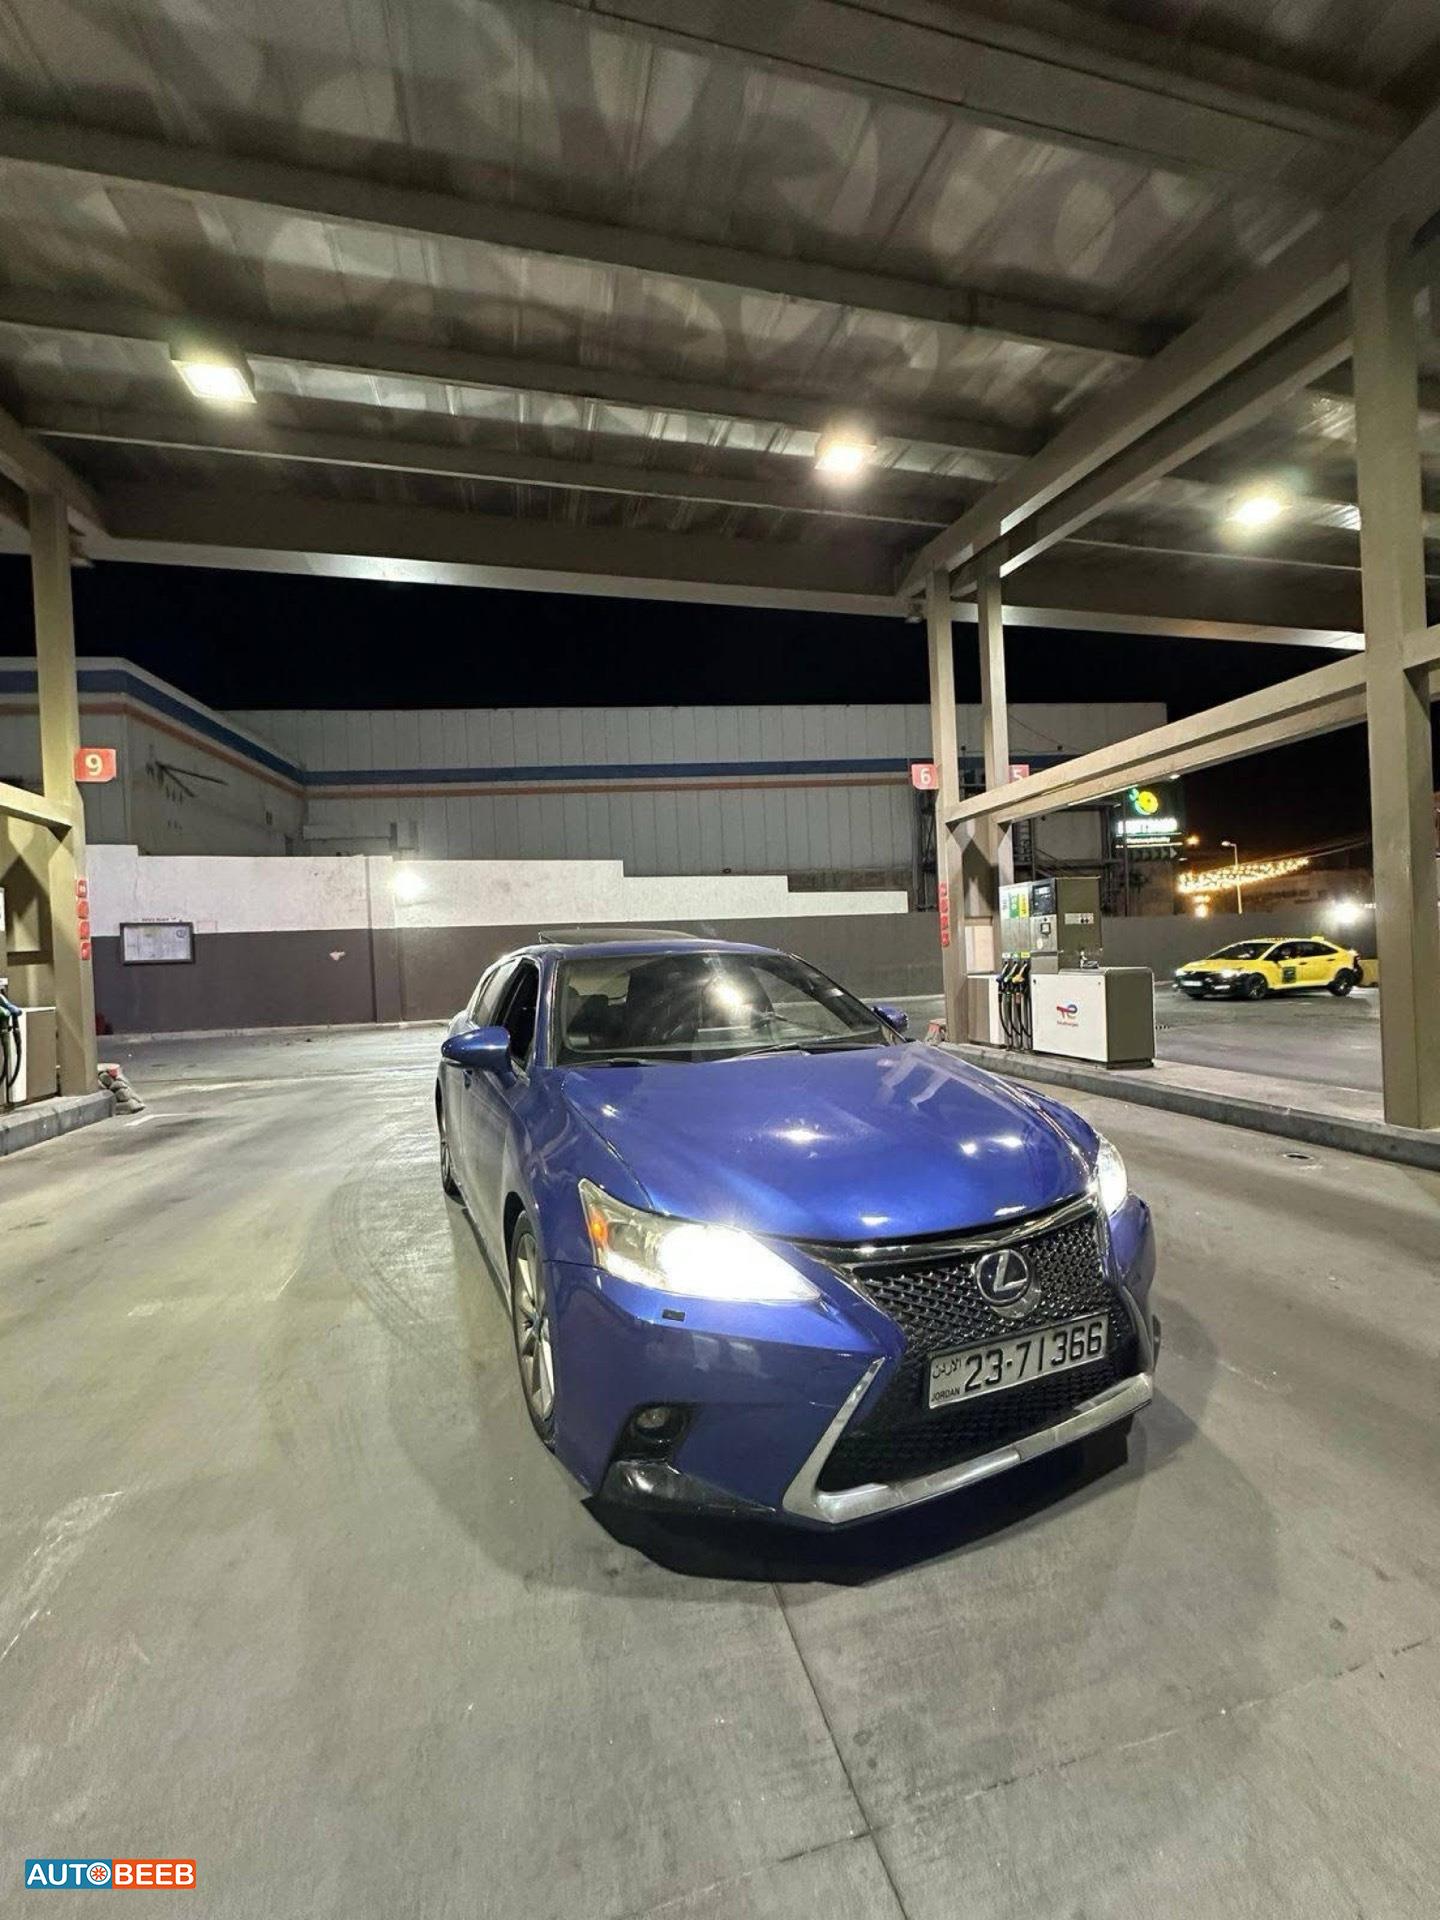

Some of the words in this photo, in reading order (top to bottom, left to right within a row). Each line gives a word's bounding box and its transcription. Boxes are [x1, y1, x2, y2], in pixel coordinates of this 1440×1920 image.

[85, 754, 103, 776] 9
[919, 767, 932, 785] 6
[964, 1321, 1103, 1393] 23-71366
[931, 1387, 961, 1402] JORDAN
